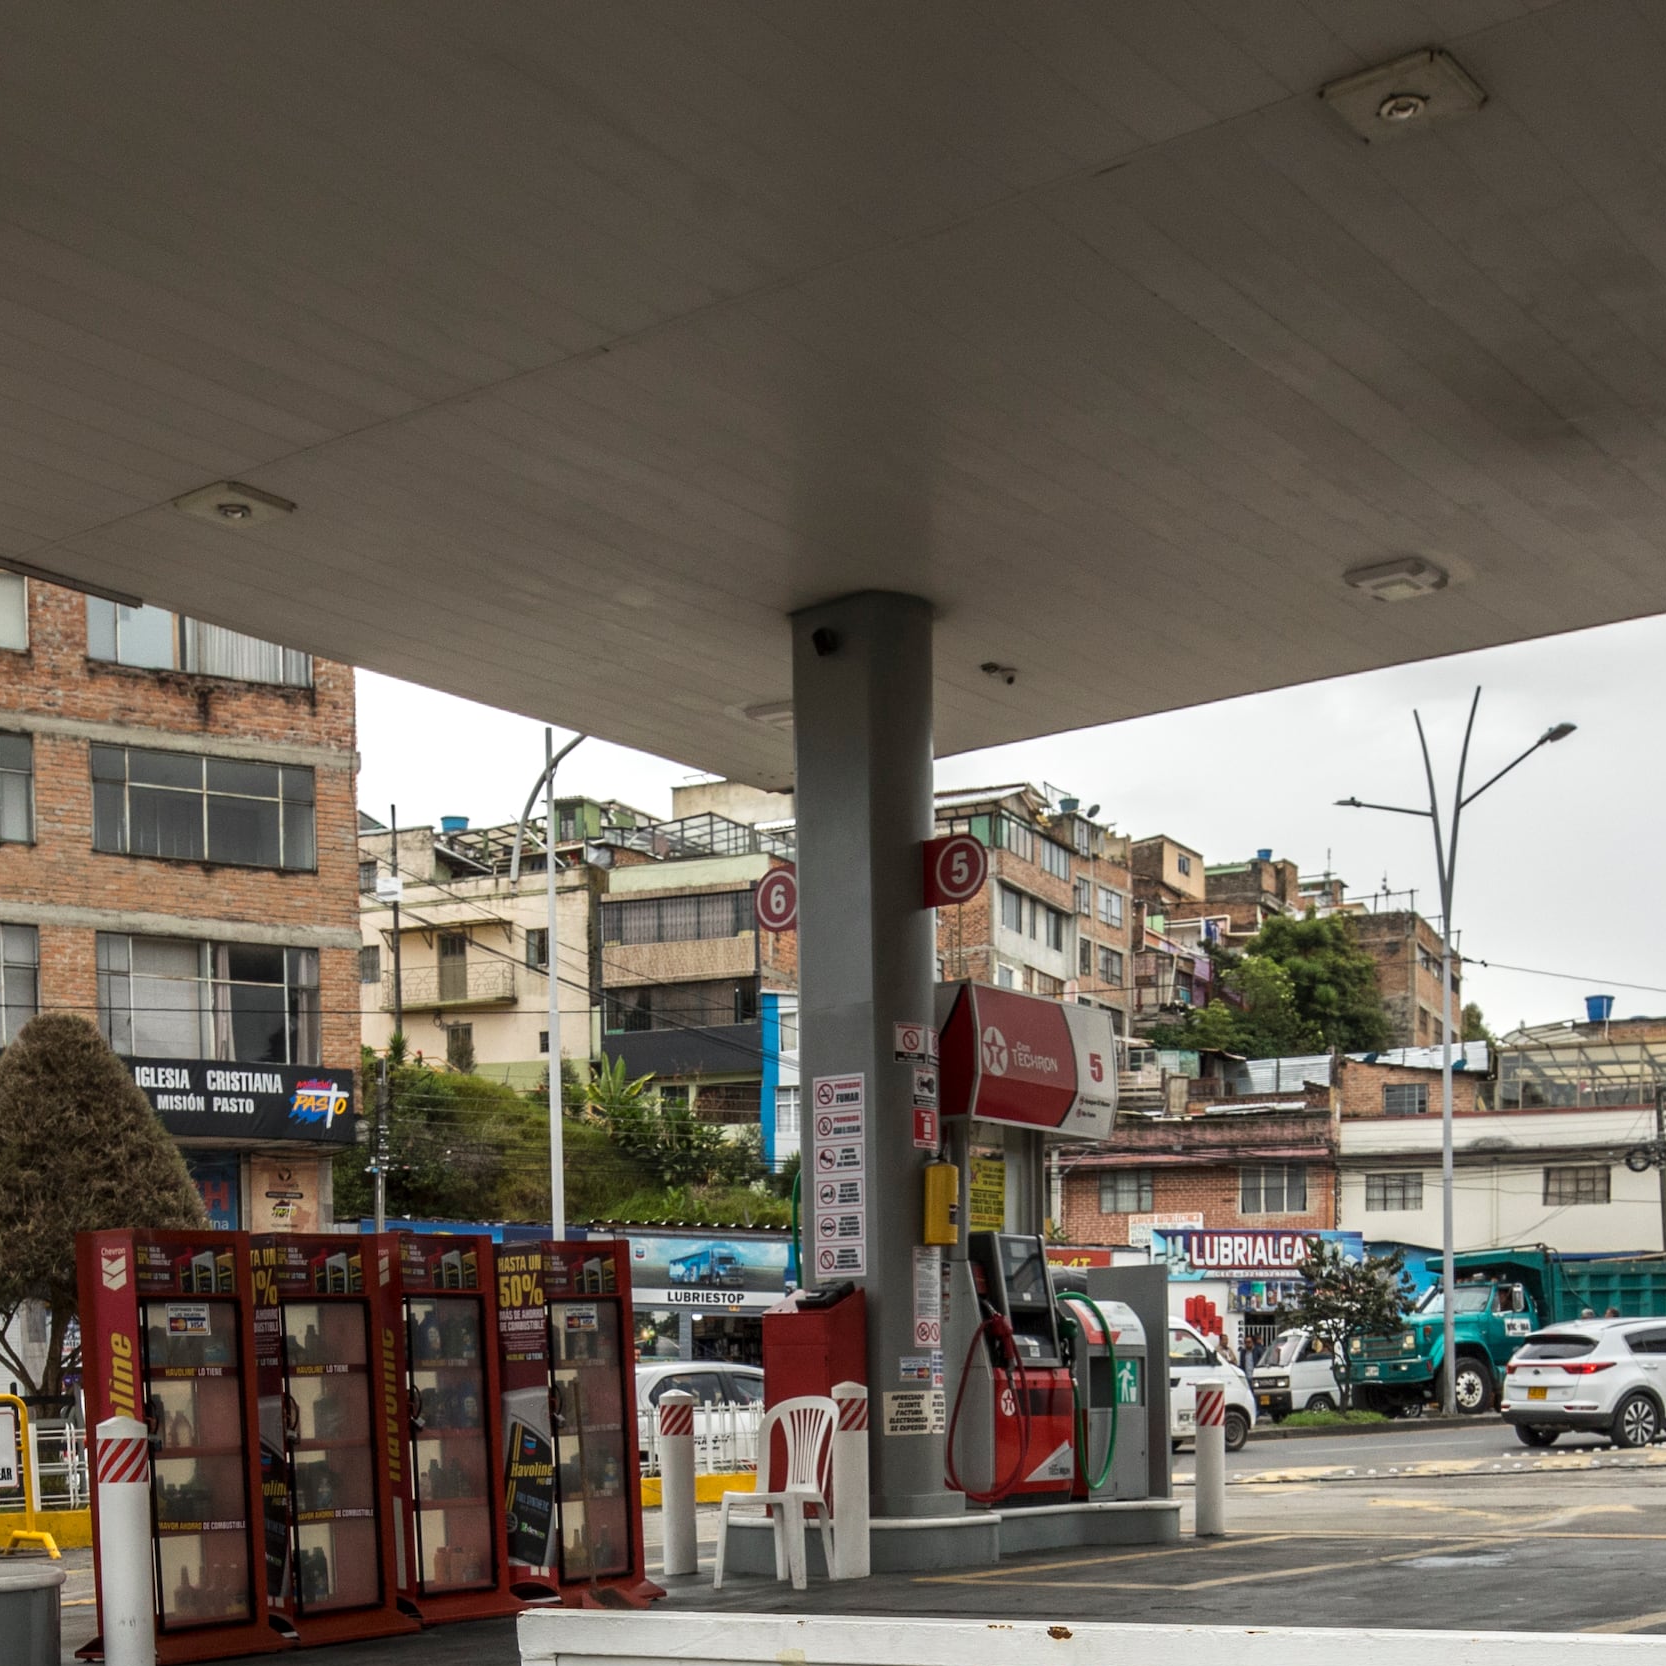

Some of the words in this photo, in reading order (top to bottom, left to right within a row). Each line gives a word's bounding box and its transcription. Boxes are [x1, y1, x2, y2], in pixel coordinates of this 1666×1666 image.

[950, 851, 970, 885] 5
[770, 885, 788, 916] 6
[1010, 1047, 1059, 1074] TECHRON
[1089, 1052, 1104, 1083] 5
[135, 1066, 191, 1090] IGLESIA
[206, 1070, 283, 1094] CRISTIANA
[157, 1093, 205, 1112] MISIÓN
[213, 1097, 255, 1114] PASTO
[835, 1092, 860, 1104] FUMAR
[101, 1247, 127, 1257] Chevron
[497, 1256, 526, 1273] HASTA
[529, 1254, 542, 1271] UN
[499, 1273, 544, 1308] 50%
[667, 1291, 745, 1304] LUBRIESTOP
[512, 1308, 521, 1320] DE
[499, 1320, 508, 1332] DE
[508, 1318, 545, 1332] COMBUSTIBLE
[206, 1367, 223, 1377] TIENE
[333, 1364, 349, 1374] TIENE
[510, 1462, 554, 1478] Havoline
[342, 1508, 374, 1519] COMBUSTIBLE
[210, 1520, 246, 1530] COMBUSTIBLE
